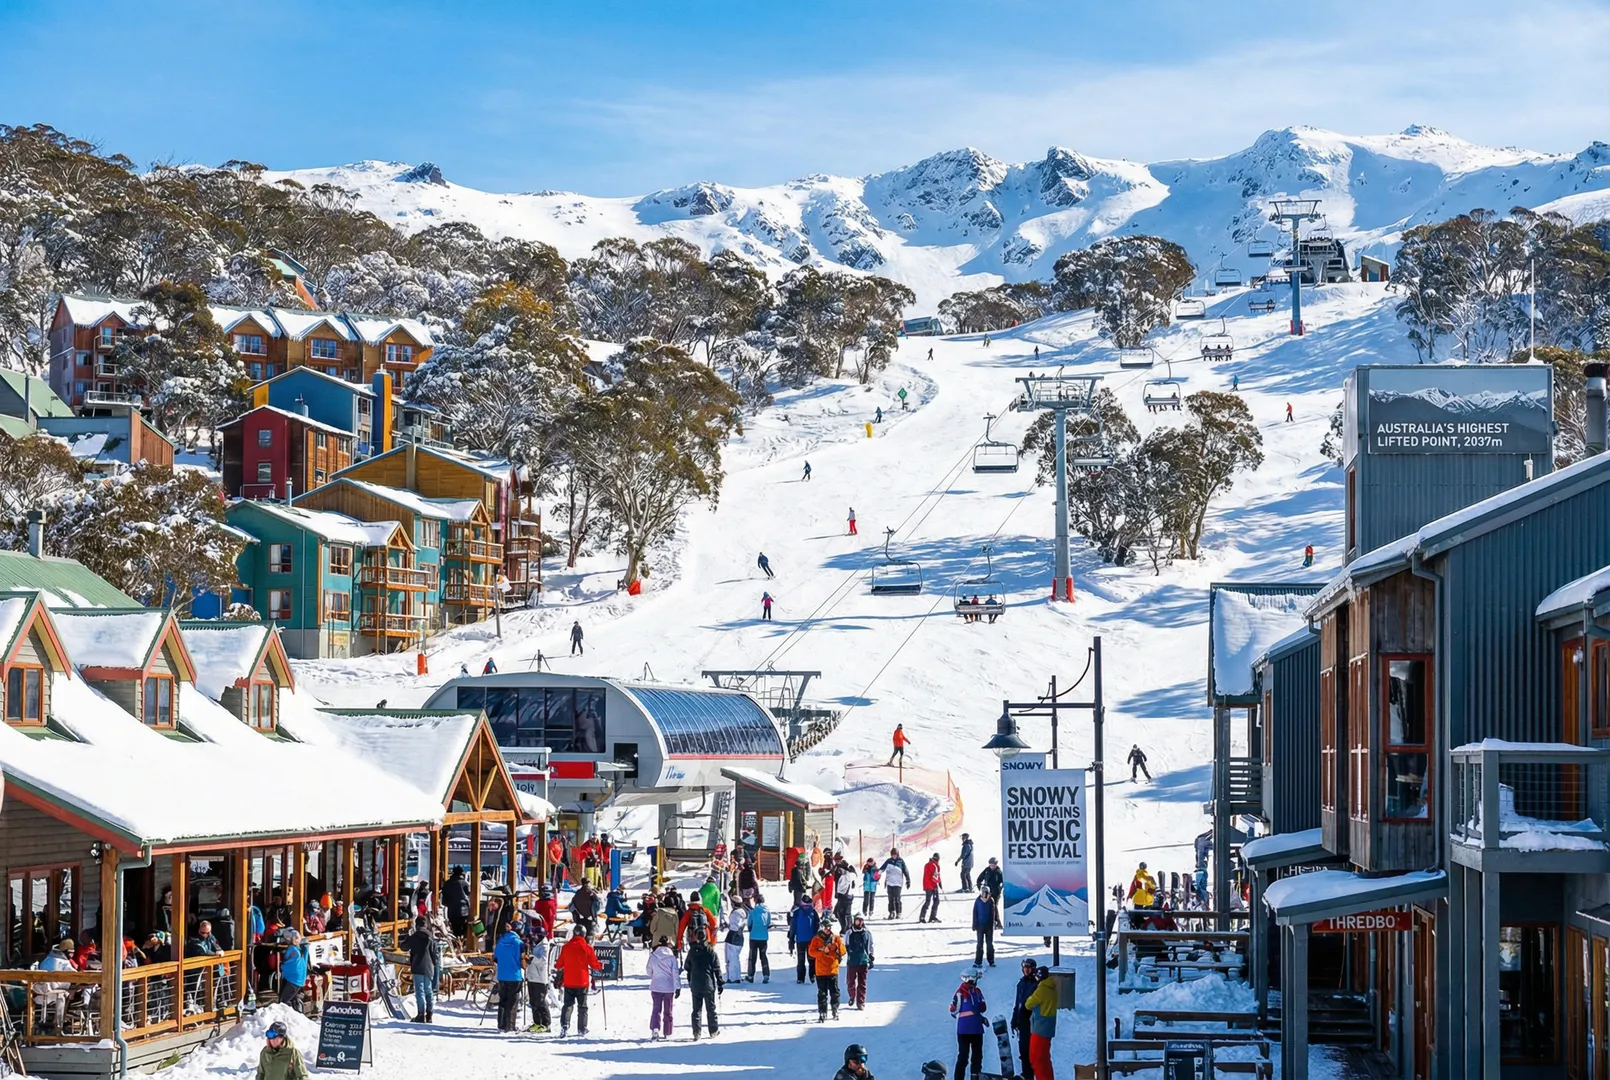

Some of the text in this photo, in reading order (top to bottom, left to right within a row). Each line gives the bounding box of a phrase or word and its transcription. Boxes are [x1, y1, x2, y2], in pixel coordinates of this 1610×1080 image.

[1377, 423, 1509, 434] AUSTRALIA'S HIGHEST
[1377, 436, 1503, 448] LIFTED POINT, 2037m
[1002, 761, 1043, 771] SNOWY
[1007, 786, 1079, 806] SNOWY
[1007, 806, 1080, 819] MOUNTAINS
[1008, 819, 1081, 842] MUSIC
[1008, 843, 1081, 859] FESTIVAL
[1329, 915, 1396, 930] THREDBO
